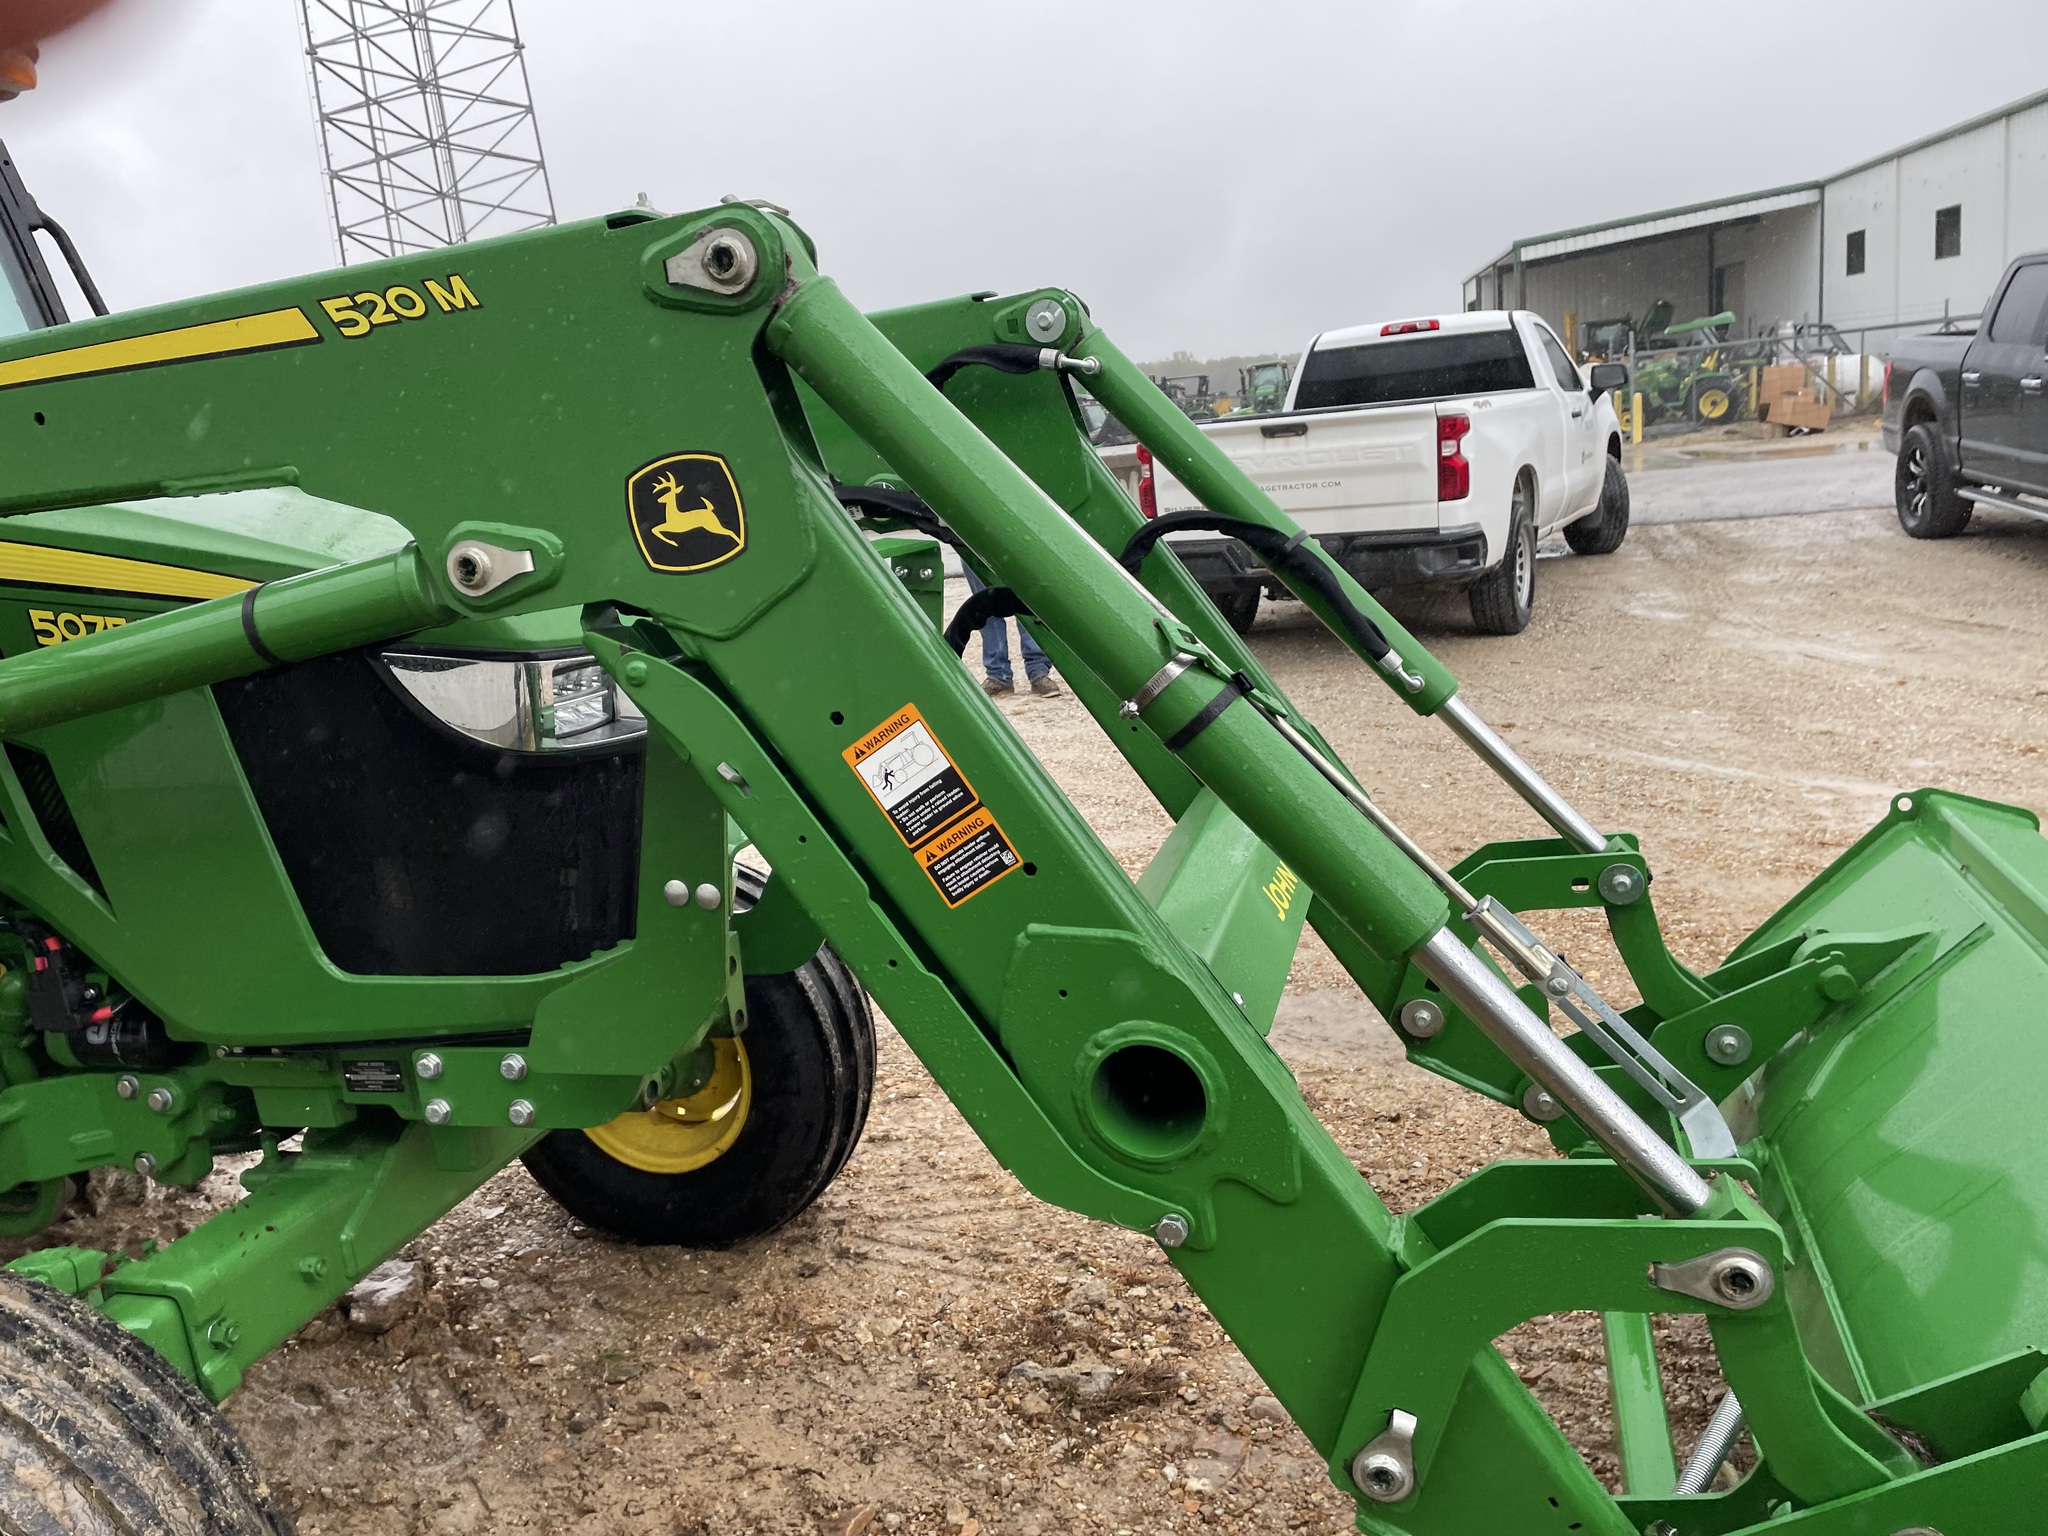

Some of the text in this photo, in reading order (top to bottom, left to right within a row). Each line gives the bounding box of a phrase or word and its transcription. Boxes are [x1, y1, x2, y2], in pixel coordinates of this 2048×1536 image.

[319, 274, 481, 338] 520 M
[1231, 443, 1413, 471] EVROLET
[863, 714, 910, 751] WARNING
[898, 801, 909, 811] avoid
[908, 794, 920, 804] injury
[919, 787, 930, 795] from
[929, 779, 942, 790] falling
[929, 790, 946, 803] perform
[906, 815, 920, 826] service
[920, 807, 931, 816] under
[934, 796, 947, 806] raised
[909, 821, 921, 831] Lower
[921, 812, 934, 822] loader
[938, 799, 953, 811] ground
[952, 792, 963, 800] when
[936, 817, 985, 853] WARNING
[949, 849, 964, 860] operate
[964, 841, 976, 850] loader
[955, 848, 976, 863] attachment
[958, 876, 970, 885] loader
[970, 866, 985, 878] causing
[964, 880, 975, 889] injury
[1262, 859, 1299, 922] JOHN
